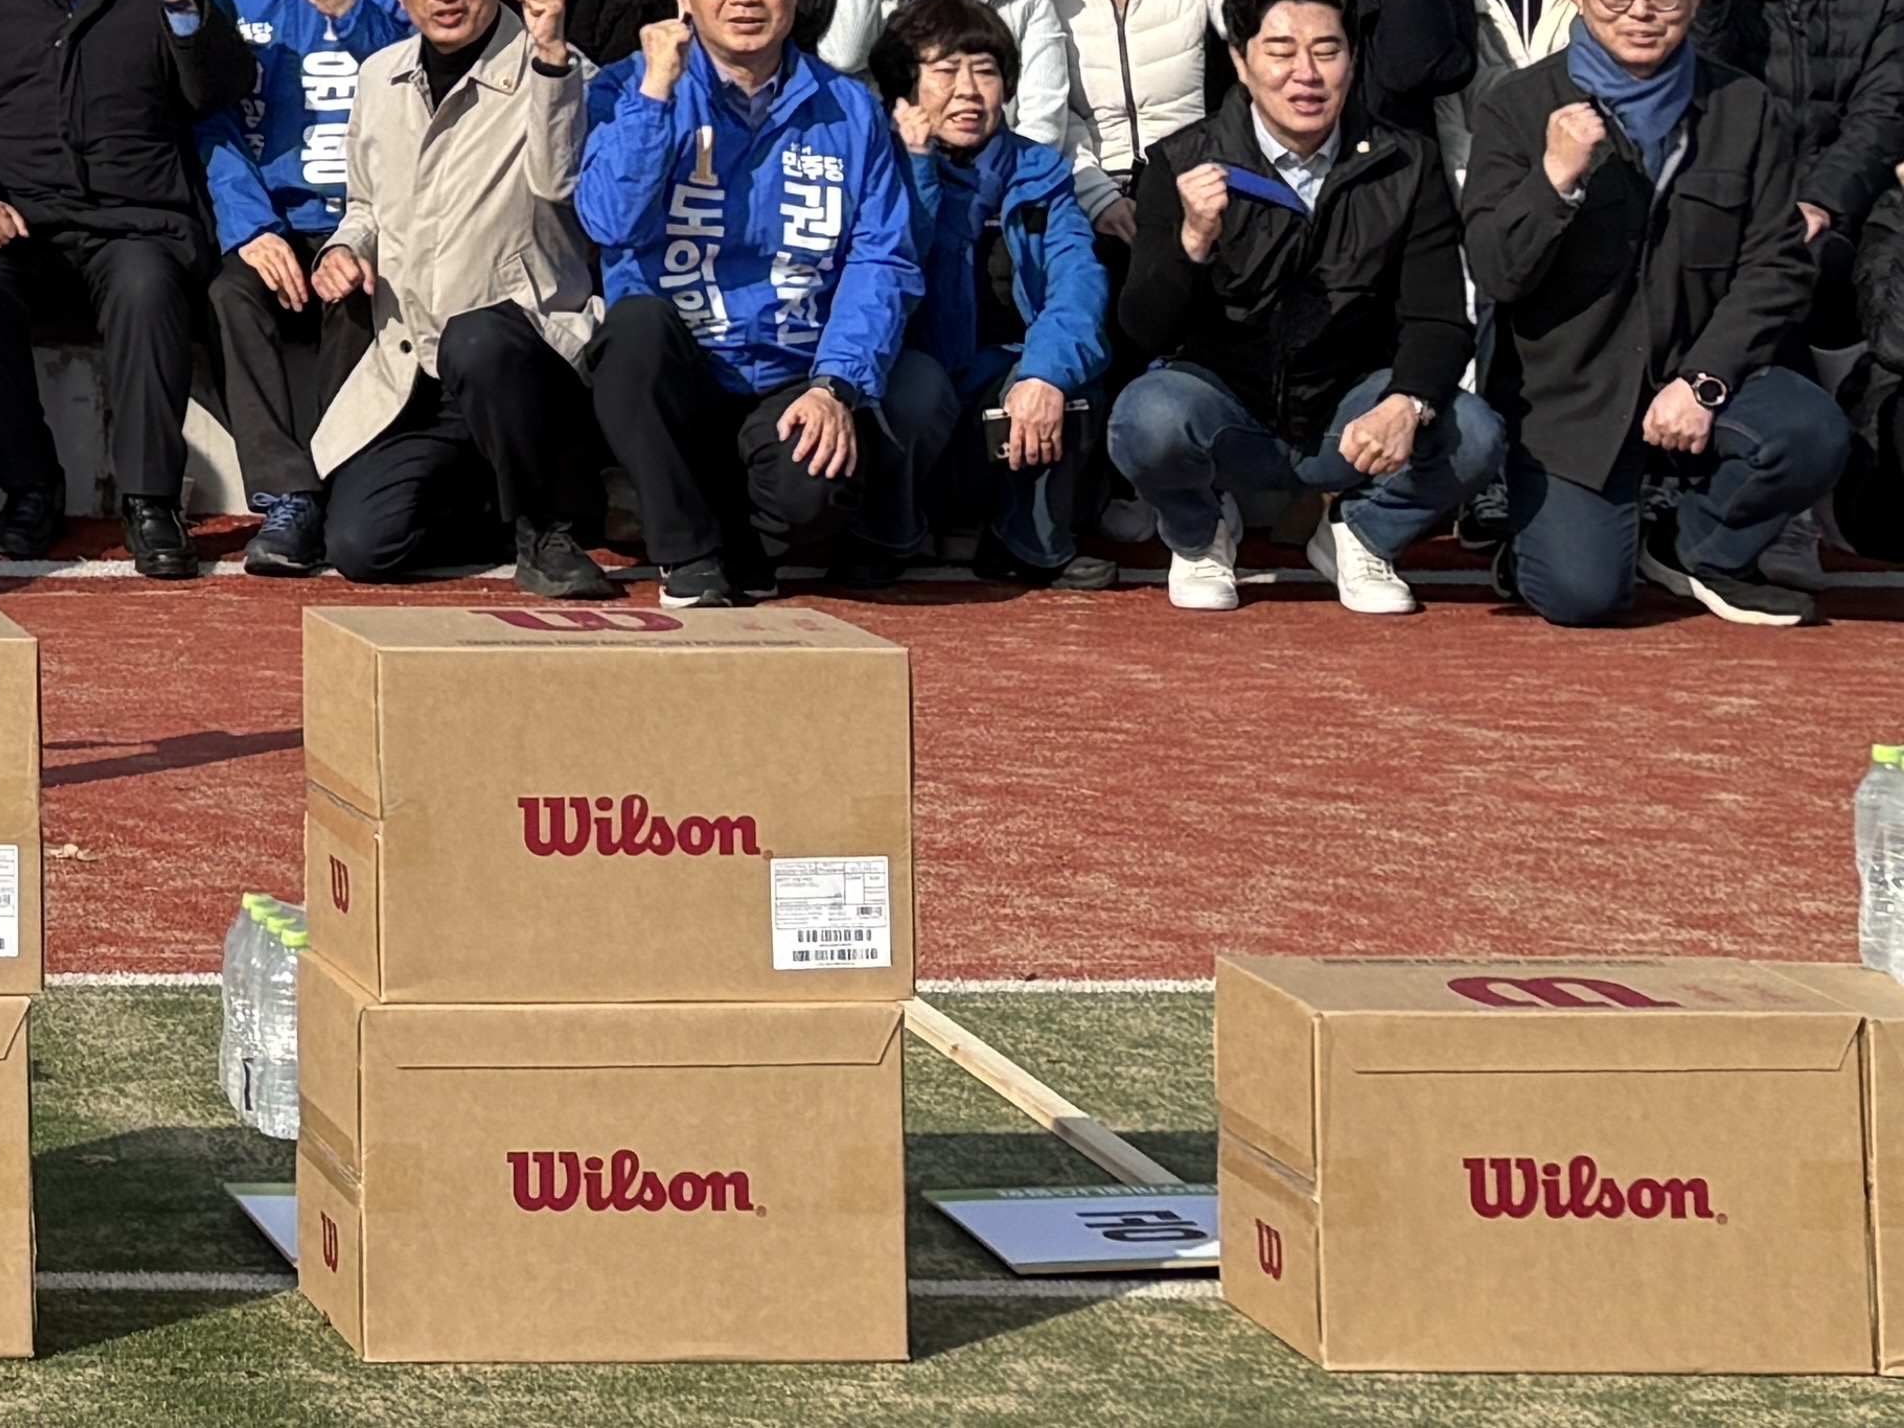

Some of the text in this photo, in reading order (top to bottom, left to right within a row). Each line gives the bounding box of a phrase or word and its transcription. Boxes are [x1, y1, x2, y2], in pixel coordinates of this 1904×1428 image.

[781, 150, 844, 182] 민주당
[518, 795, 761, 858] Wilson
[507, 1149, 754, 1213] Wilson
[1464, 1155, 1714, 1220] Wilson
